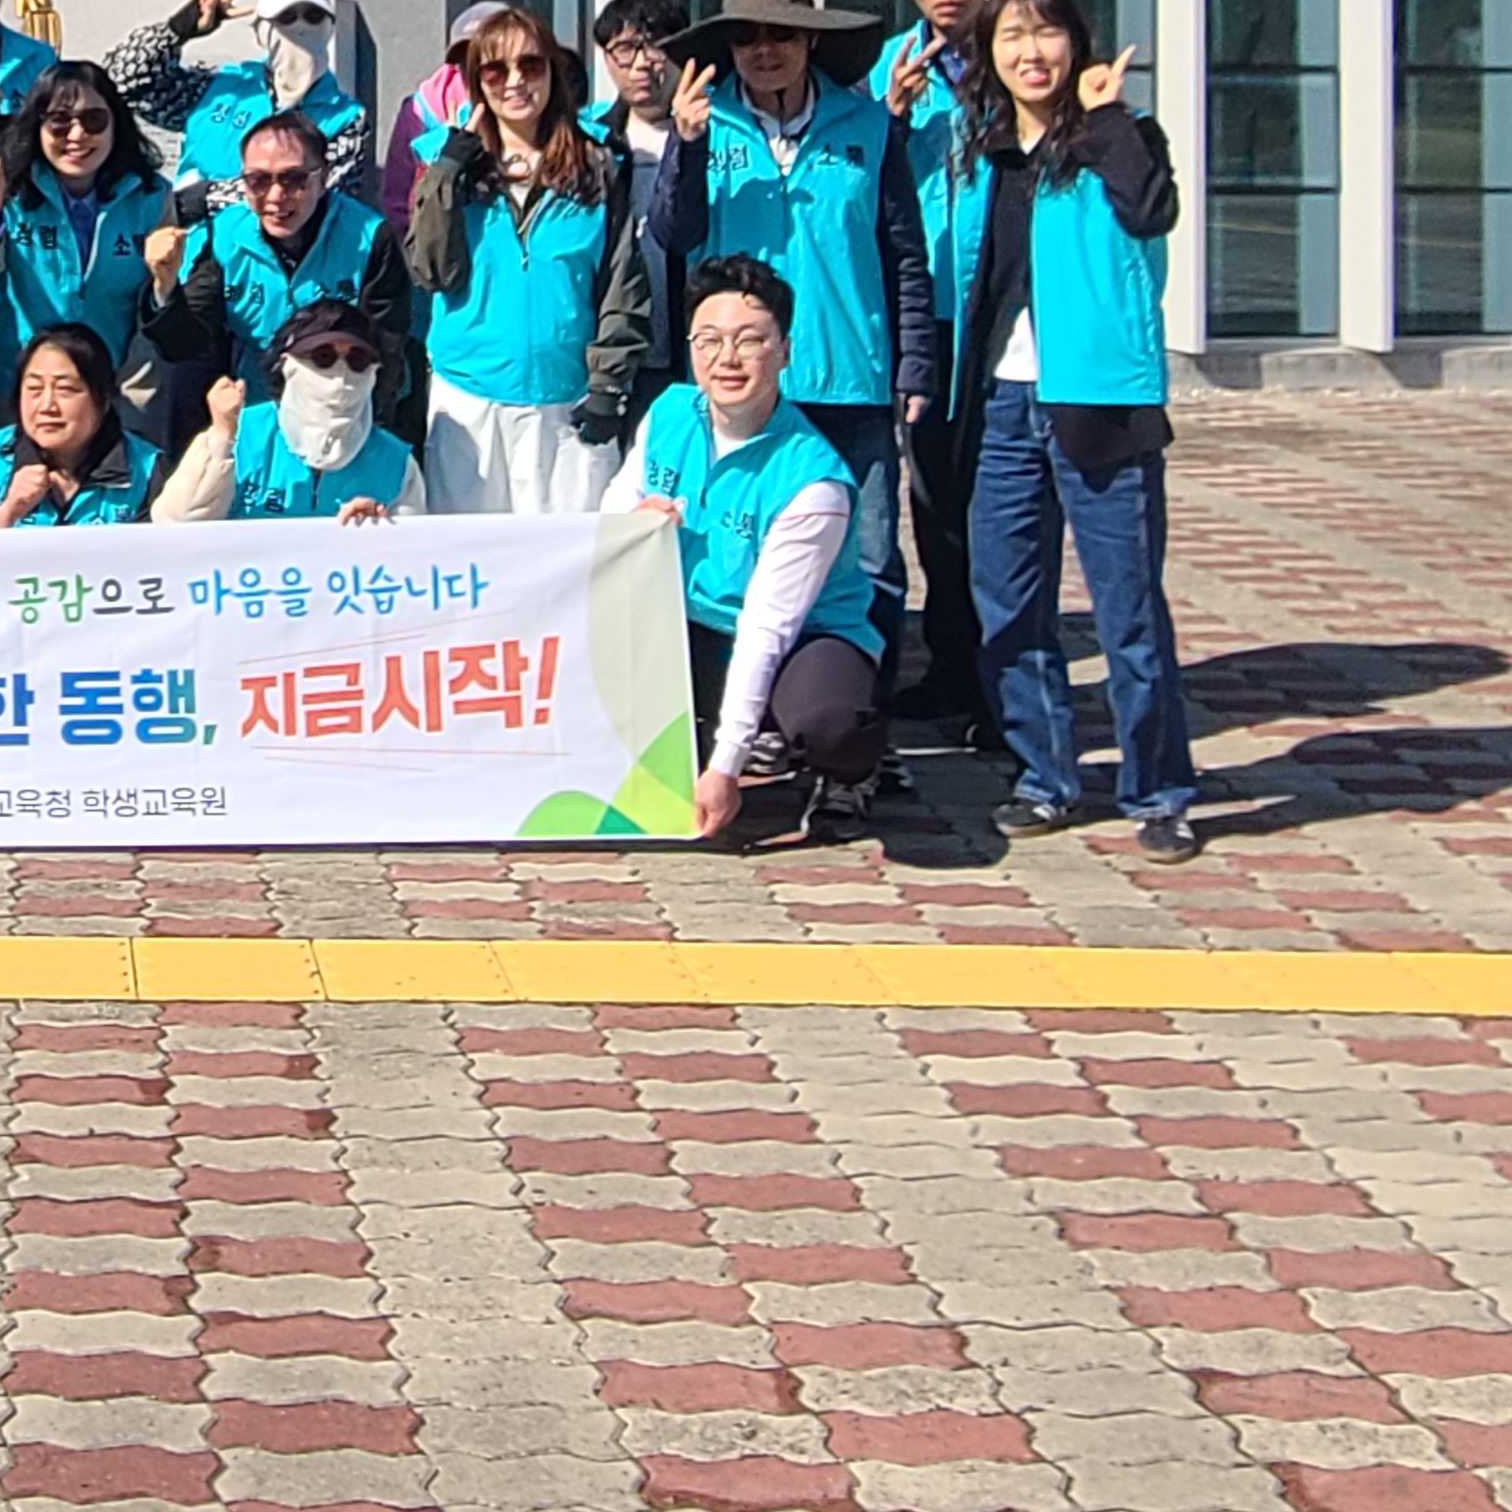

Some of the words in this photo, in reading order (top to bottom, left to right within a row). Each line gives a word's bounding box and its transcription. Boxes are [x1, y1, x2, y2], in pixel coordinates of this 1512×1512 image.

[8, 573, 174, 624] 공감으로
[188, 567, 312, 618] 마음을
[327, 563, 489, 614] 잇습니다
[58, 668, 217, 746] 동행,
[240, 636, 559, 738] 지금시작!
[82, 787, 228, 818] 학생교육원
